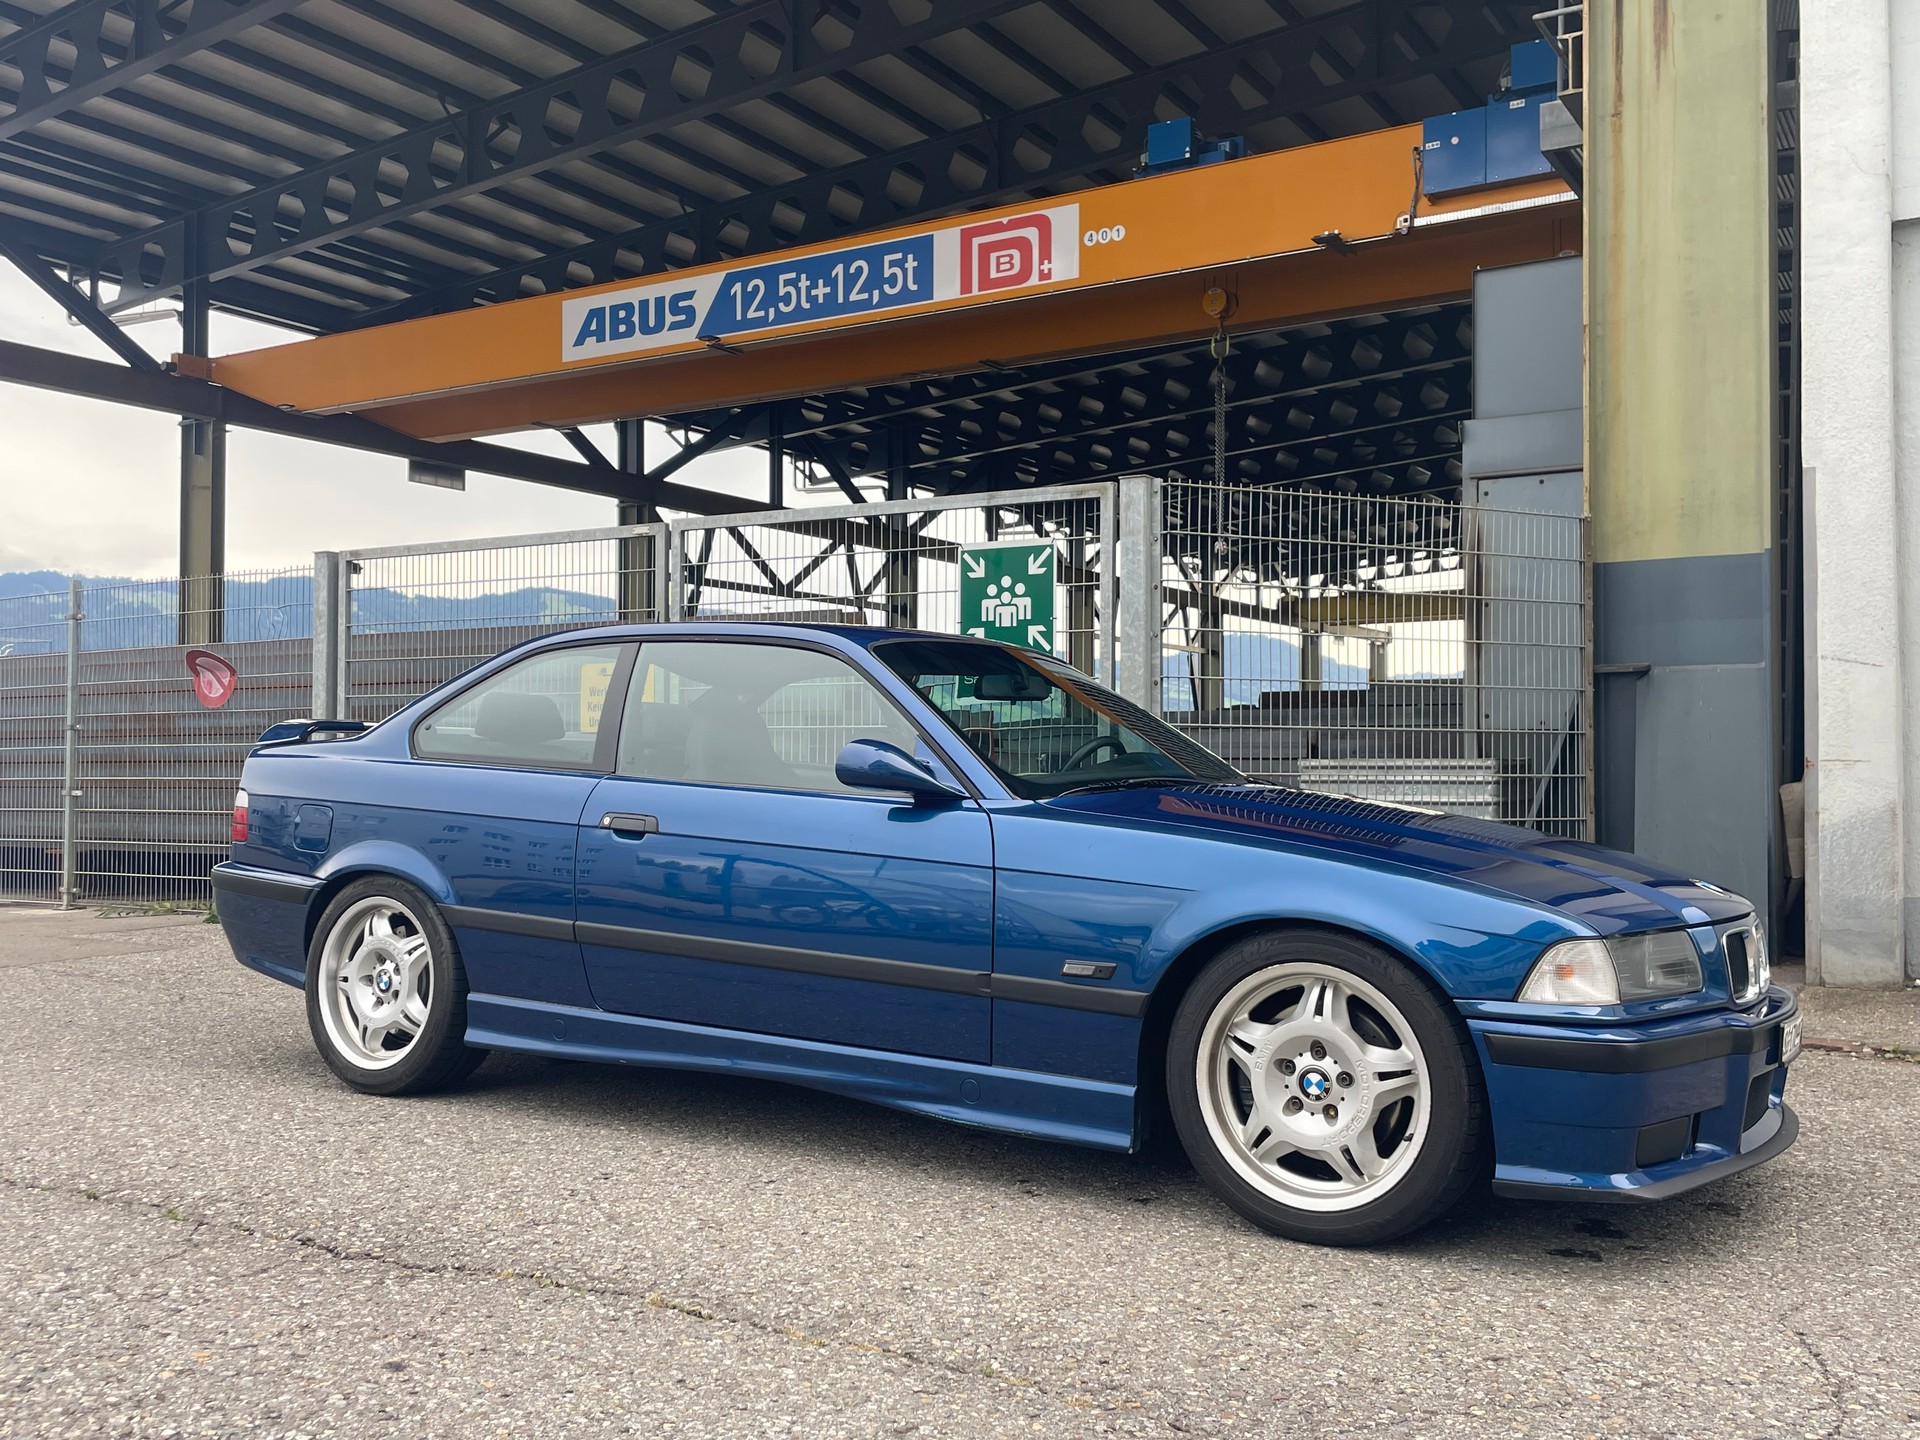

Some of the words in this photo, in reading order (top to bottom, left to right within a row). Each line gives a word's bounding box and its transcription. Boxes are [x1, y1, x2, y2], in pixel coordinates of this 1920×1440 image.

[572, 289, 697, 348] ABUS
[730, 252, 918, 324] 12,5t+12,5t
[1255, 1039, 1275, 1073] BMW
[1321, 1058, 1371, 1148] MOTORSPORT
